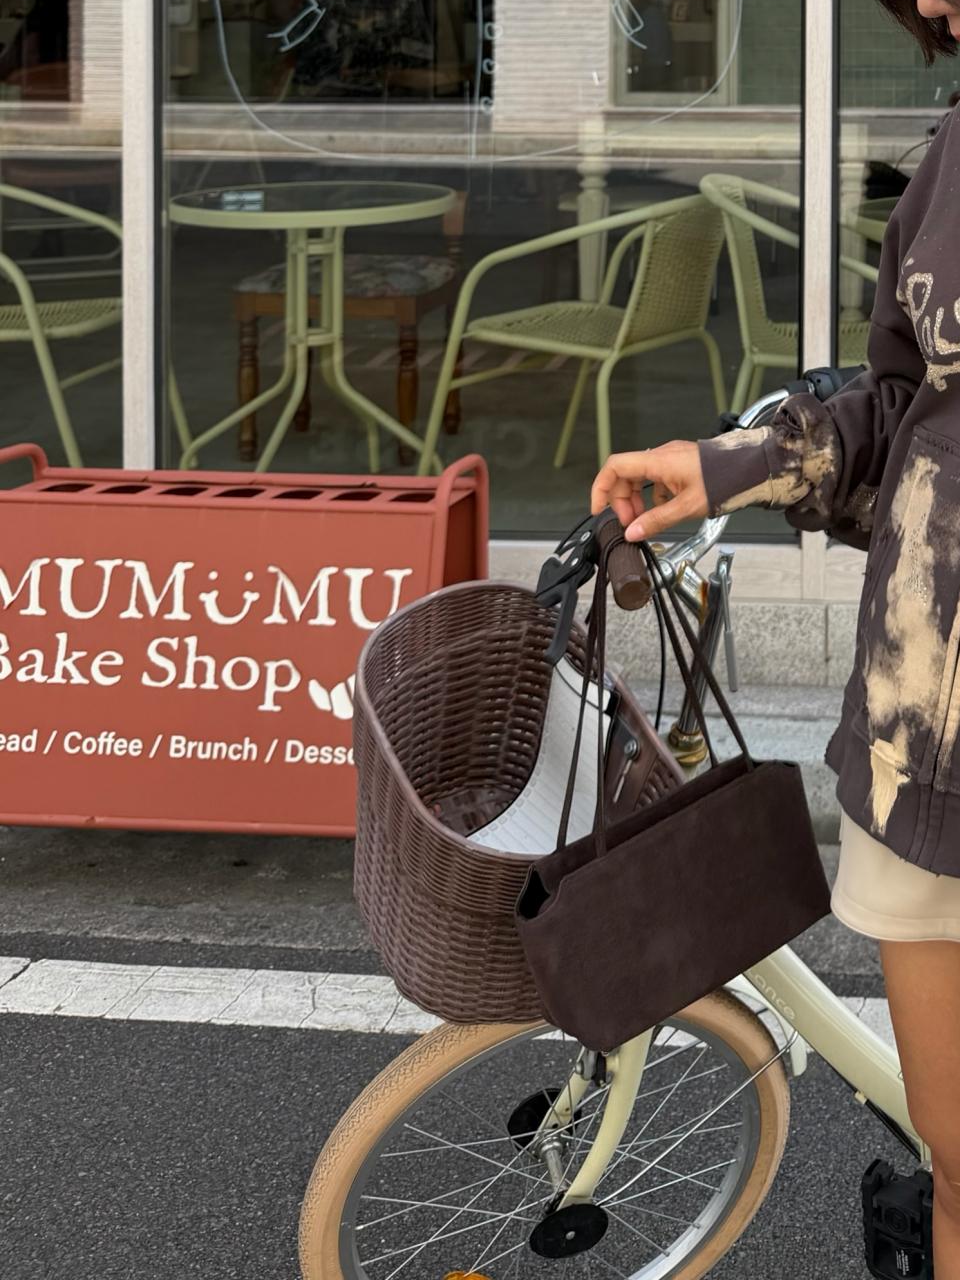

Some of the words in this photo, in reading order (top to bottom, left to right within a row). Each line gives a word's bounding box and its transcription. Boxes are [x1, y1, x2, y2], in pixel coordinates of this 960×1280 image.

[141, 635, 301, 713] Shop
[63, 730, 144, 757] Coffee
[169, 735, 258, 761] Brunch
